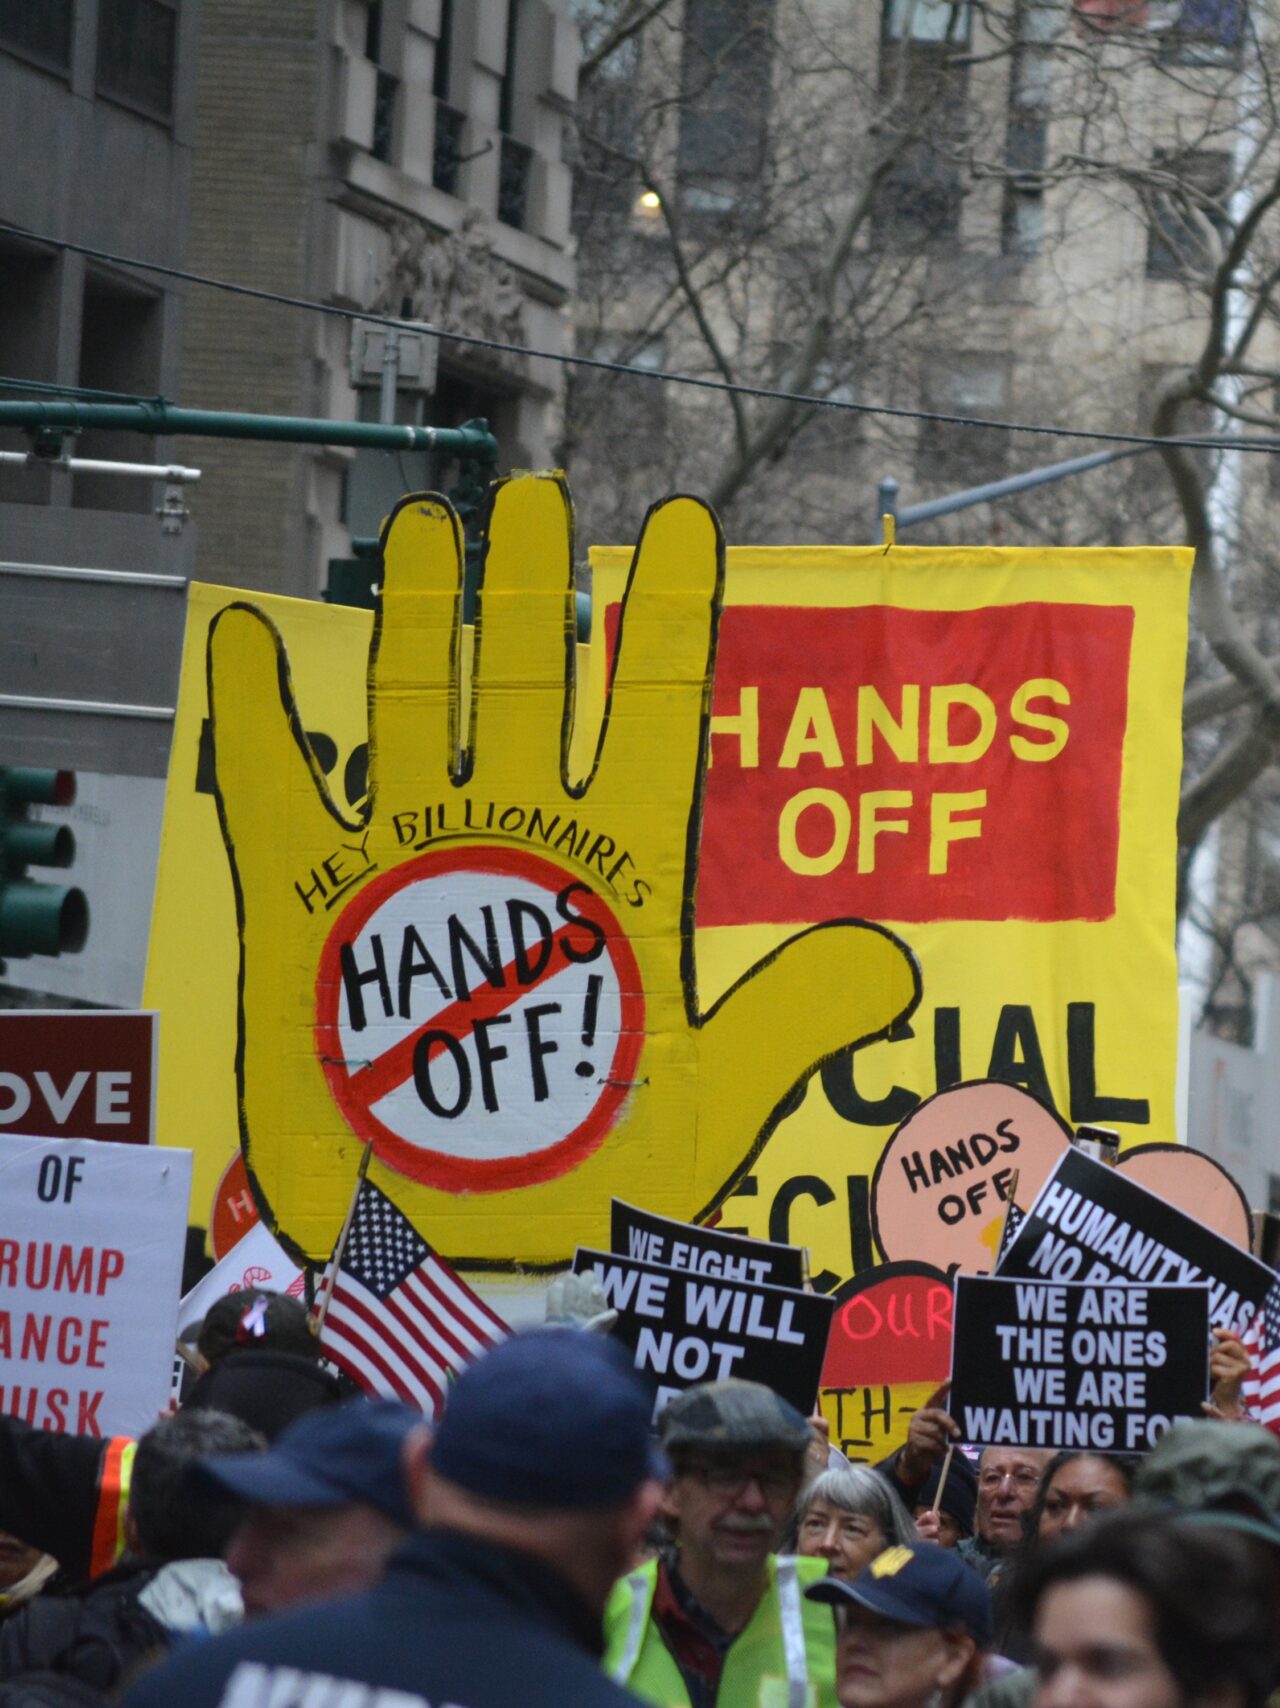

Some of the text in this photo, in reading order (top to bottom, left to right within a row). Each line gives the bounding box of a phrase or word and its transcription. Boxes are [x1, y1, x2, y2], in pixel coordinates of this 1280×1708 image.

[708, 678, 1071, 769] HANDS
[294, 798, 653, 914] HEY BILLIONAIRES
[777, 787, 986, 876] OFF
[340, 882, 607, 1031] HANDS
[411, 974, 604, 1120] OFF!
[790, 1001, 1150, 1127] CIAL
[36, 1154, 86, 1204] OF
[900, 1118, 1021, 1194] HANDS
[937, 1167, 1013, 1226] OFF
[628, 1225, 773, 1285] WE FIGHT
[1028, 1231, 1083, 1283] NO
[1035, 1180, 1202, 1284] HUMANITY
[593, 1261, 806, 1346] WE WILL
[841, 1285, 954, 1341] OUR
[1015, 1284, 1148, 1326] WE ARE
[633, 1327, 746, 1384] NOT
[996, 1325, 1168, 1368] THE ONES
[1013, 1367, 1147, 1409] WE ARE
[964, 1406, 1196, 1448] WAITING FO
